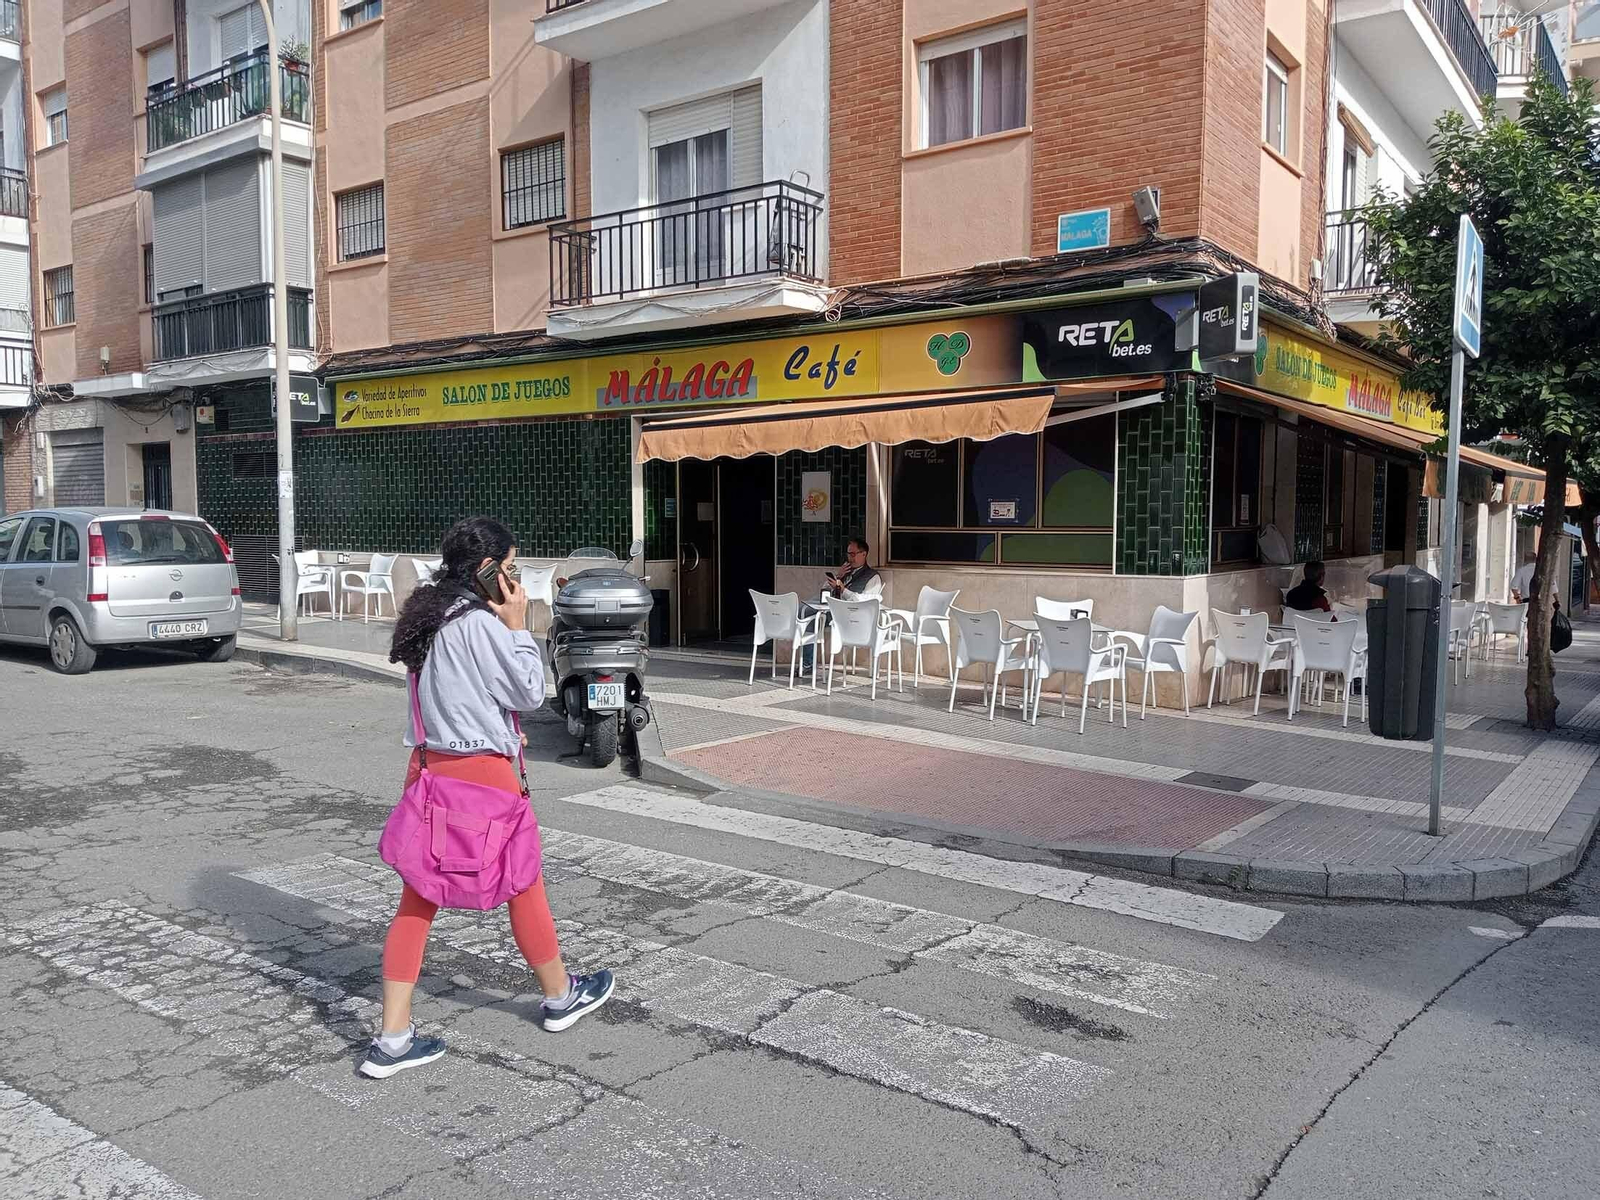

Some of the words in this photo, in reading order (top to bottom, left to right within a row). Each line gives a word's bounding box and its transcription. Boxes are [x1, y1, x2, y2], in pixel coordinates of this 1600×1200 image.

[1202, 305, 1229, 323] RETA
[1058, 319, 1134, 350] RETA
[1111, 343, 1153, 357] bet.es
[604, 356, 754, 406] MÁLAGA
[783, 343, 862, 391] Café
[1314, 362, 1337, 390] JUEGOS
[289, 391, 310, 402] ETA
[361, 385, 387, 402] Variedad
[388, 385, 396, 400] de
[397, 383, 427, 402] Aperitivos
[442, 384, 488, 405] SALON
[491, 382, 511, 401] DE
[514, 376, 570, 400] JUEGOS
[1348, 367, 1392, 417] MÁLAGA
[361, 405, 384, 420] Chacina
[385, 403, 393, 418] de
[394, 402, 401, 417] la
[402, 403, 420, 417] Sierra
[904, 448, 937, 458] RETA
[159, 624, 182, 634] 4440
[184, 622, 203, 633] CRZ
[596, 685, 622, 696] 7201
[596, 696, 617, 707] HMJ
